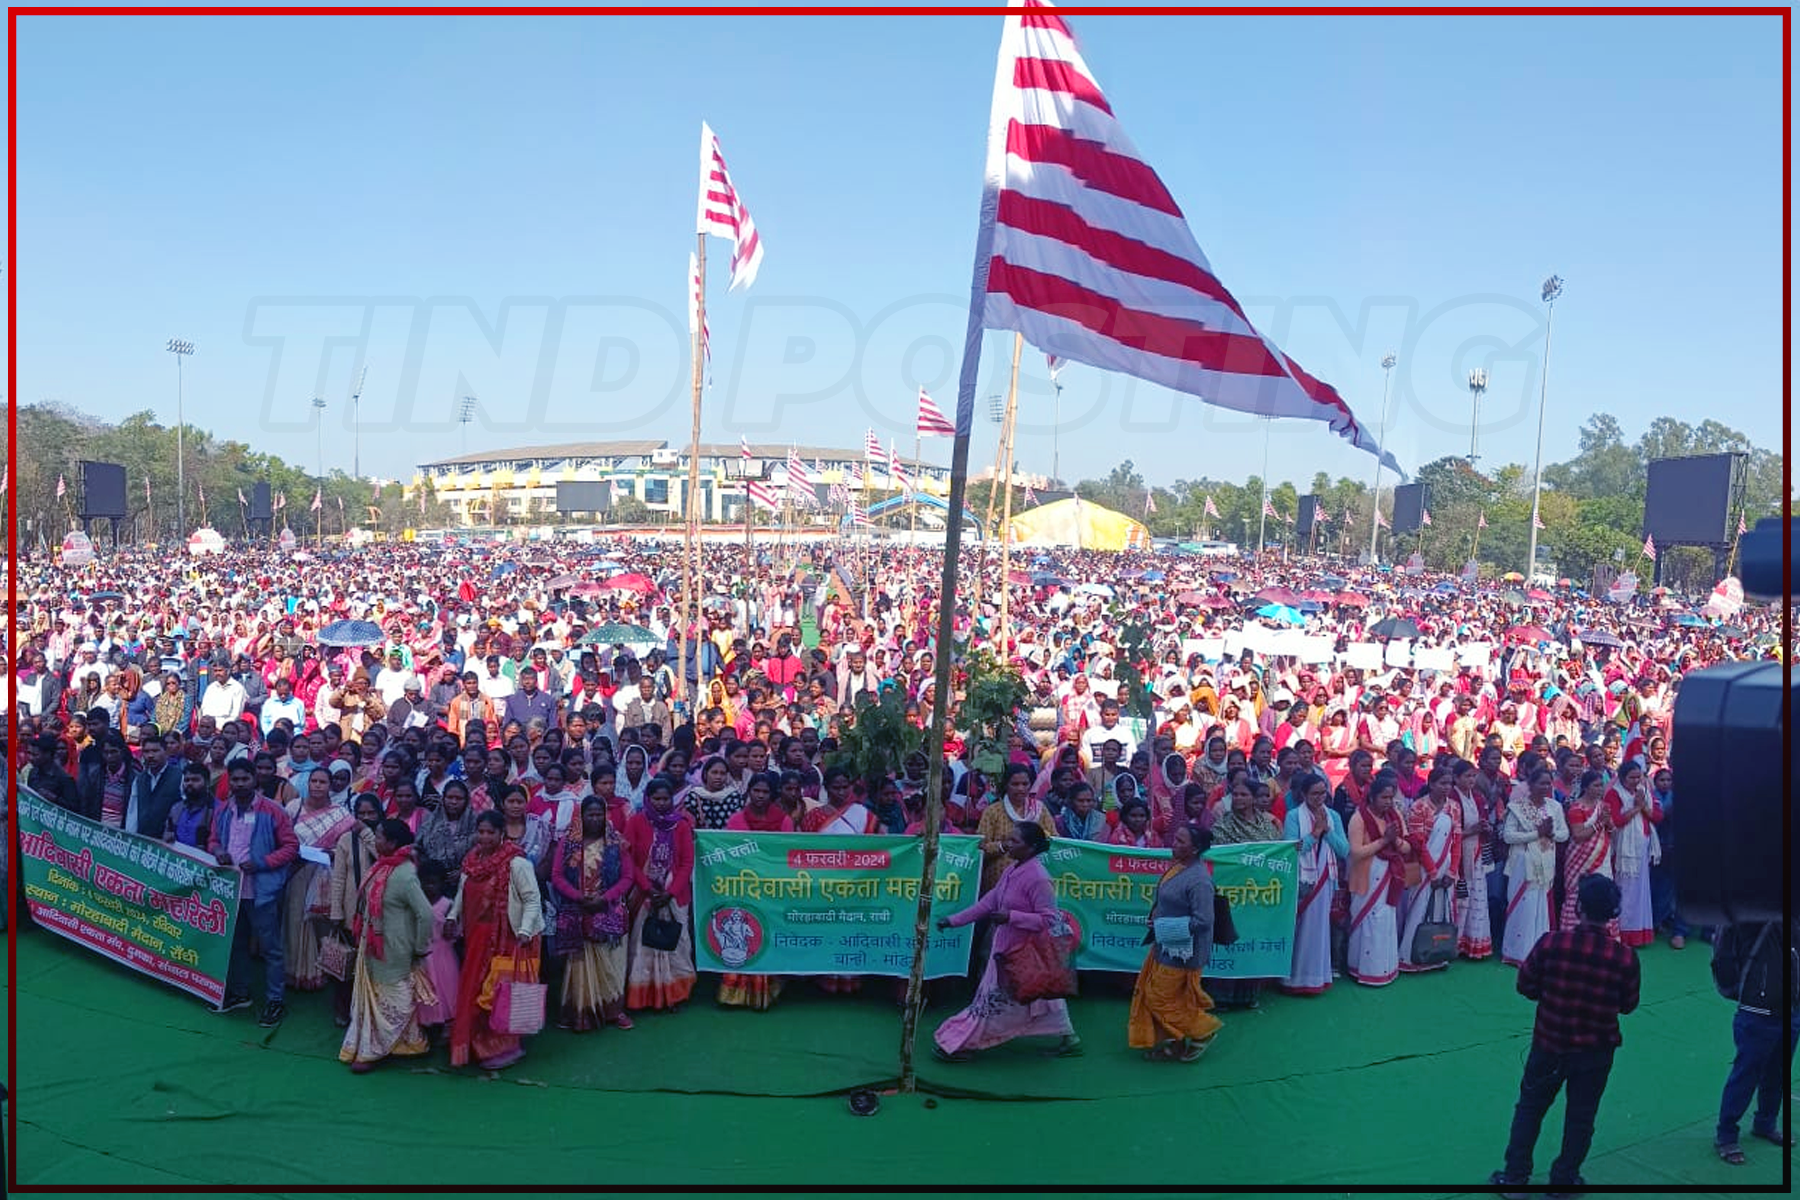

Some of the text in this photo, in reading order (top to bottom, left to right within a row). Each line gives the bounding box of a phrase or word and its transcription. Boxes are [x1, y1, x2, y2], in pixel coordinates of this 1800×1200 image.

[700, 847, 726, 867] रांची
[793, 854, 802, 866] 4
[853, 854, 886, 867] 2024
[20, 830, 230, 937] आदिवासी एकता महारैली
[24, 883, 60, 905] स्थान
[711, 868, 814, 900] आदिवासी
[818, 877, 881, 902] एकता
[1053, 871, 1135, 901] दिवासी
[48, 868, 79, 893] दिनांक
[153, 914, 182, 939] रविवार
[37, 905, 79, 931] आदिवासी
[774, 931, 824, 949] निवेदक
[839, 932, 901, 949] आदिवासी
